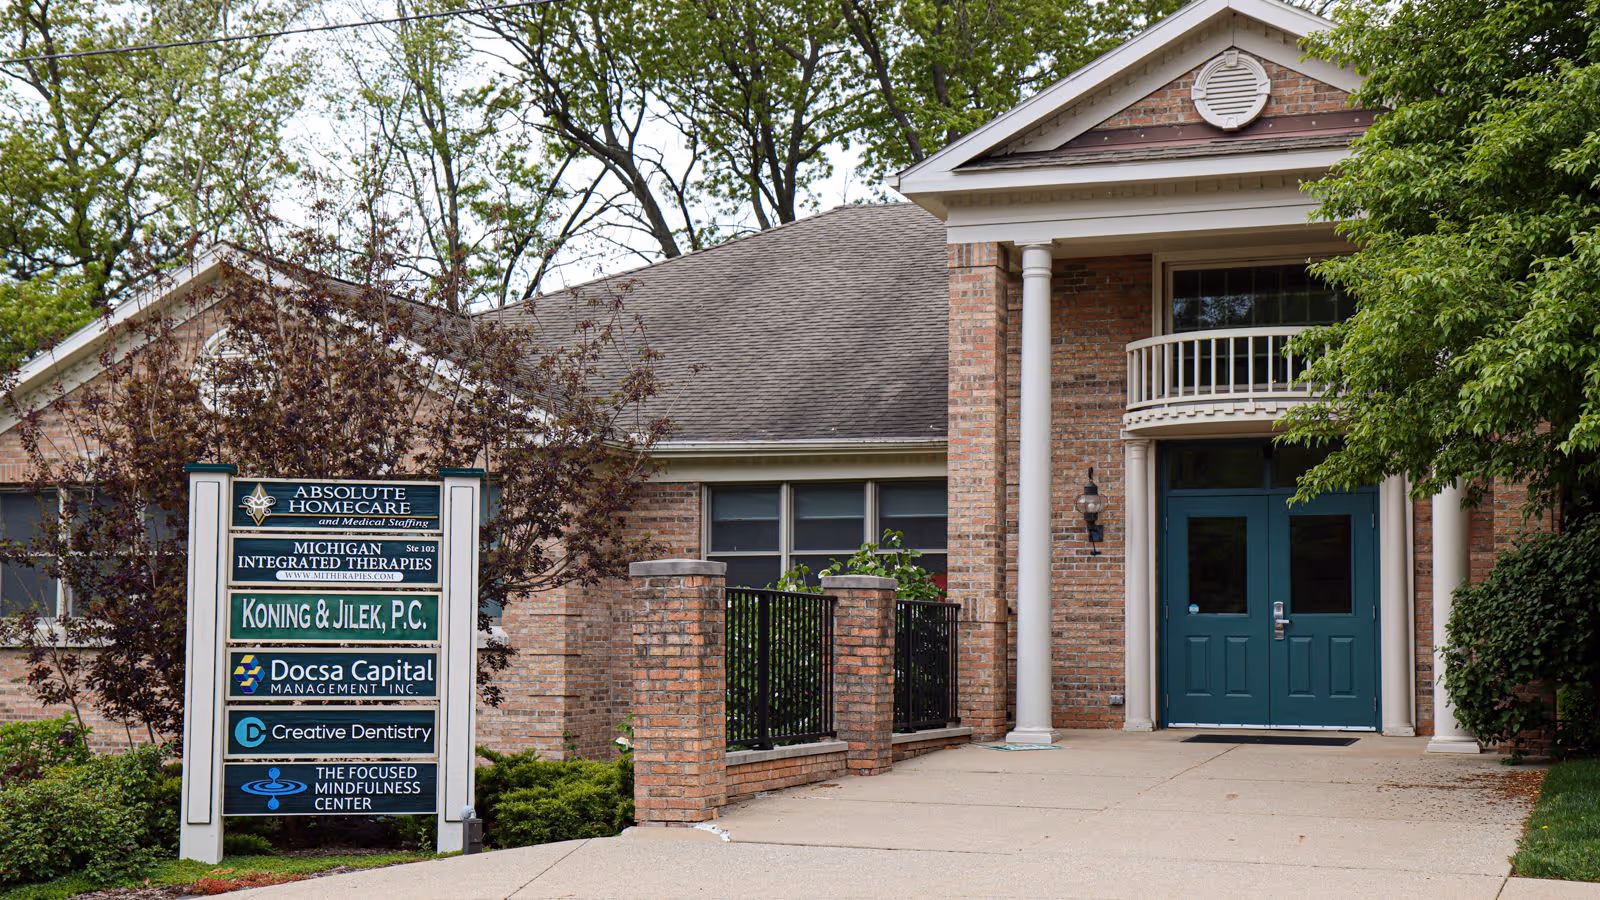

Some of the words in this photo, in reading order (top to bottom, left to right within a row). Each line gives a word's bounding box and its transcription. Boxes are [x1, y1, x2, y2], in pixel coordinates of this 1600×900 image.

[293, 486, 406, 500] ABSOLUTE
[288, 500, 412, 515] HOMECARE
[319, 518, 339, 526] and
[343, 518, 385, 526] Medical
[388, 518, 429, 528] Staffing
[293, 542, 382, 555] MICHIGAN
[406, 544, 419, 552] Ste
[421, 545, 435, 553] 102
[238, 556, 341, 569] INTEGRATED
[346, 558, 432, 571] THERAPIES
[285, 572, 395, 580] WWW.MITHERAPIES.COM
[315, 599, 330, 628] &
[391, 600, 427, 630] P.C.
[271, 660, 343, 681] Docsa
[352, 659, 433, 686] Capital
[270, 683, 377, 694] MANAGEMENT
[389, 684, 419, 695] INC.
[272, 724, 347, 740] Creative
[352, 724, 431, 742] Dentistry
[316, 767, 345, 779] THE
[349, 766, 417, 779] FOCUSED
[315, 781, 421, 795] MINDFULNESS
[315, 798, 372, 810] CENTER
